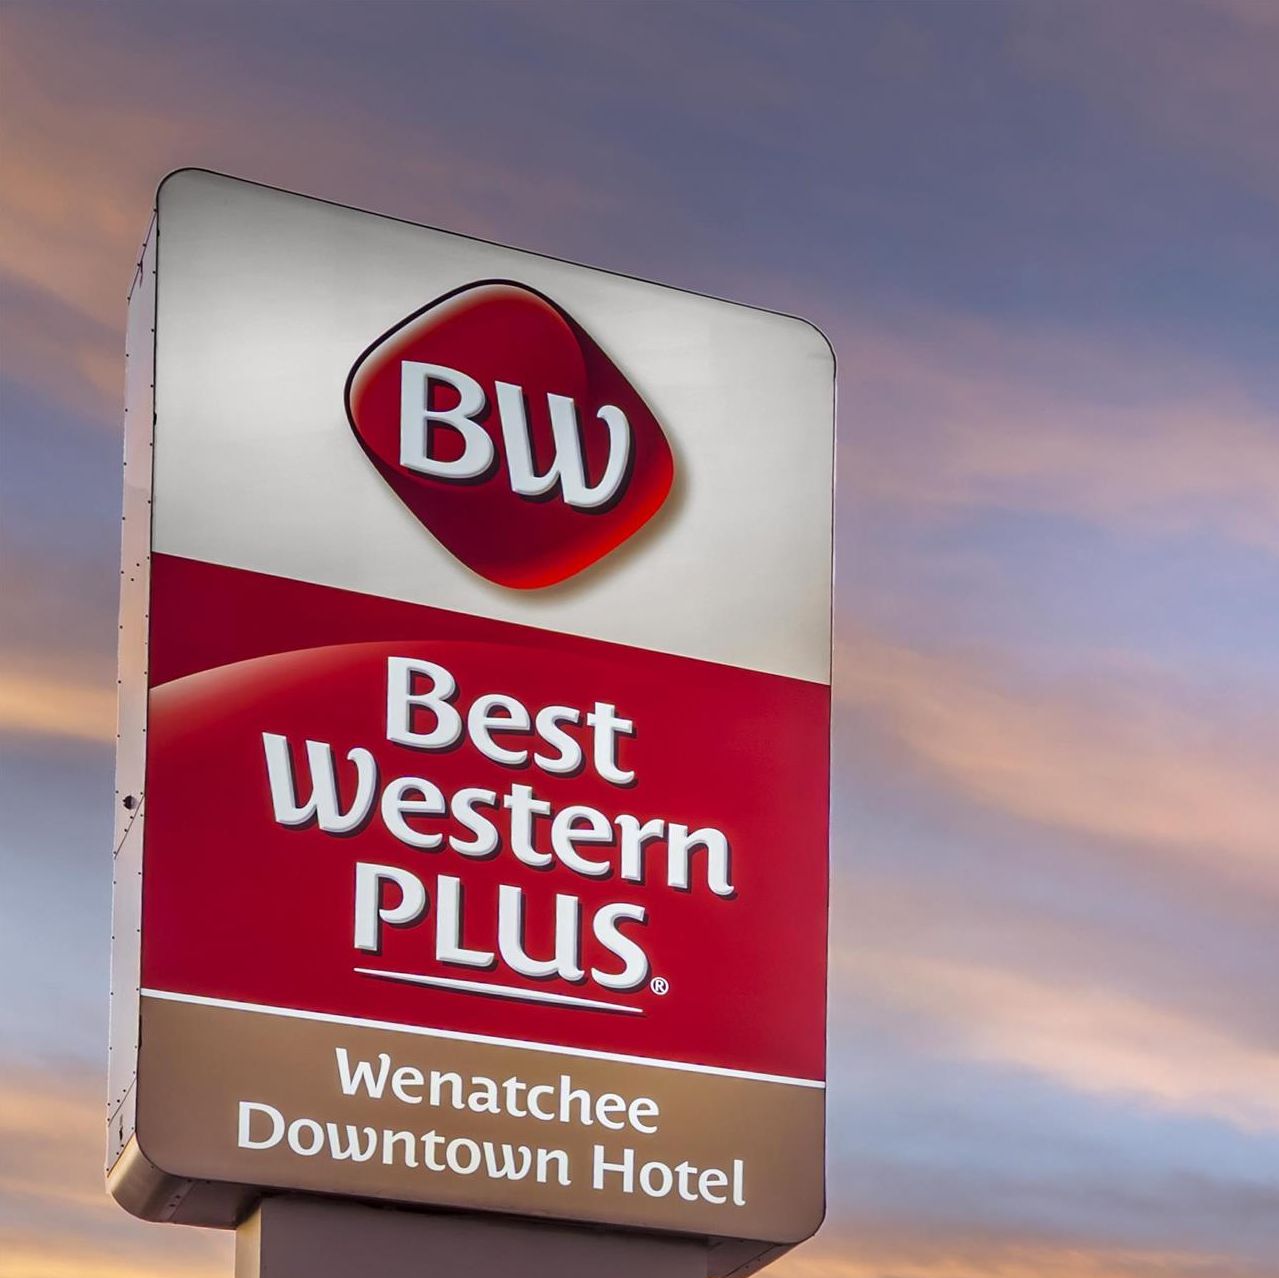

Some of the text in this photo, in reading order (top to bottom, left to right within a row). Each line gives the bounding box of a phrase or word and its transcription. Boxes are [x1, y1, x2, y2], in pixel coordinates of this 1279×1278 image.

[399, 359, 632, 509] BW
[386, 655, 636, 786] Best
[261, 731, 737, 897] Western
[237, 1101, 747, 1207] Downtown Hotel
[335, 1047, 661, 1135] Wenatchee
